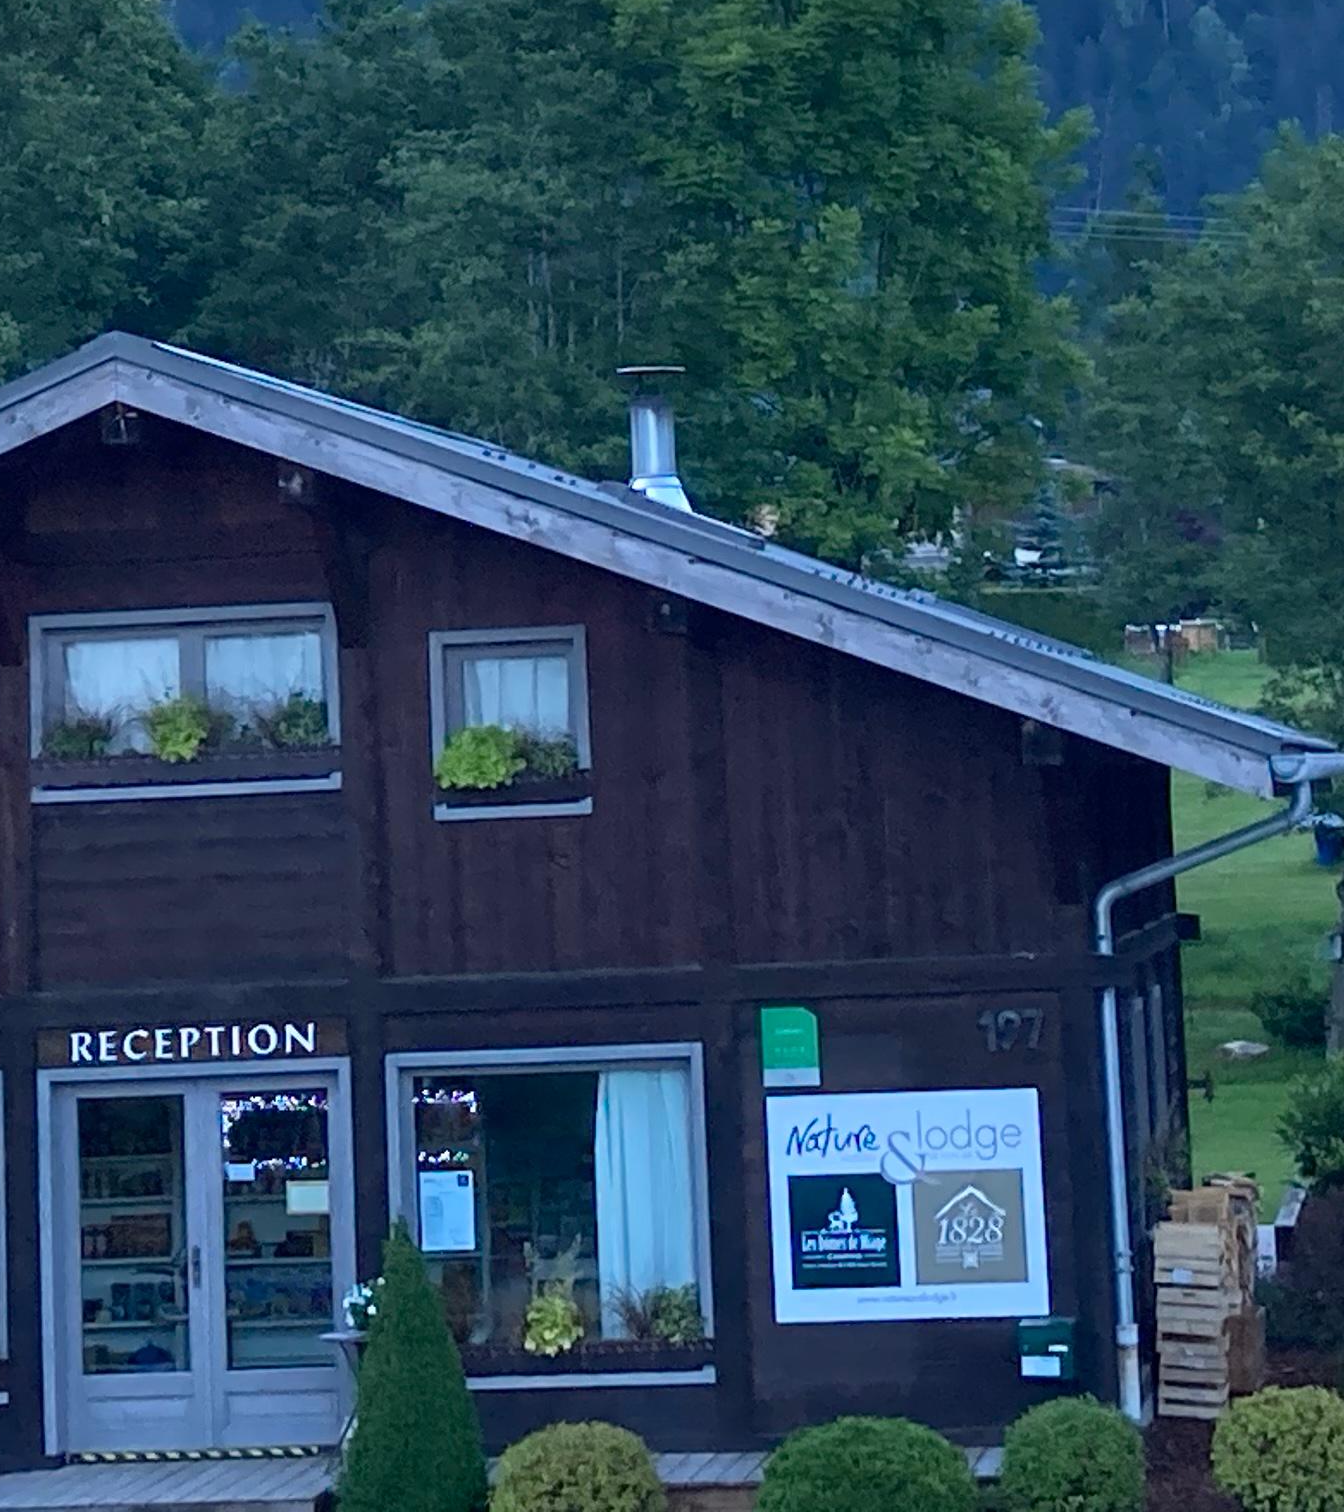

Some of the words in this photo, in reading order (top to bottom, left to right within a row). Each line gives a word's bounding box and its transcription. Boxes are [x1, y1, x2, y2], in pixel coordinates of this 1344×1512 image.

[69, 1022, 316, 1063] RECEPTION
[978, 1008, 1043, 1052] 197
[785, 1113, 880, 1158] Nature
[915, 1108, 1023, 1161] lodge
[937, 1215, 1005, 1245] 1828
